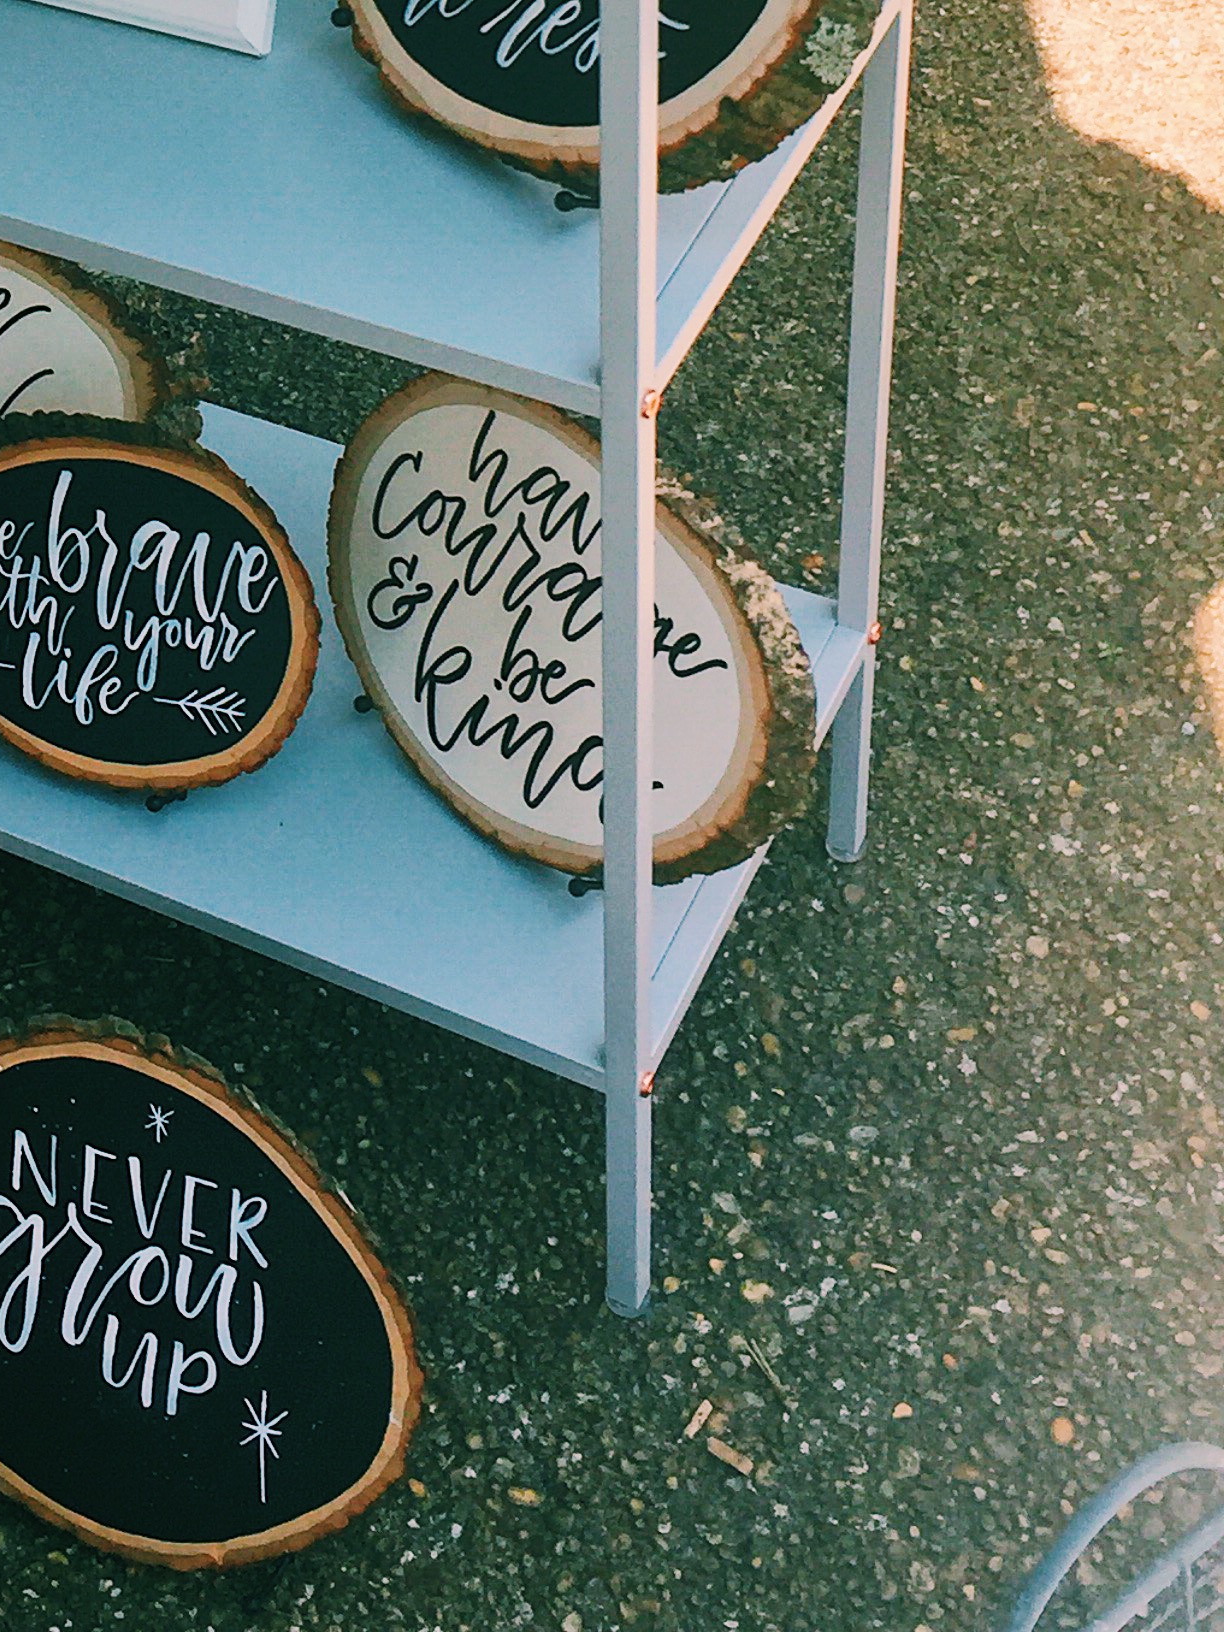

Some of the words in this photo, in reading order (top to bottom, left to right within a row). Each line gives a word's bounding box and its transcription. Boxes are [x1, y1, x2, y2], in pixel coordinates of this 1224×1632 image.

[48, 469, 279, 630] brave
[22, 631, 140, 726] life
[124, 609, 256, 692] your
[367, 555, 433, 630] &
[500, 605, 596, 704] be
[12, 1129, 269, 1269] NEVER
